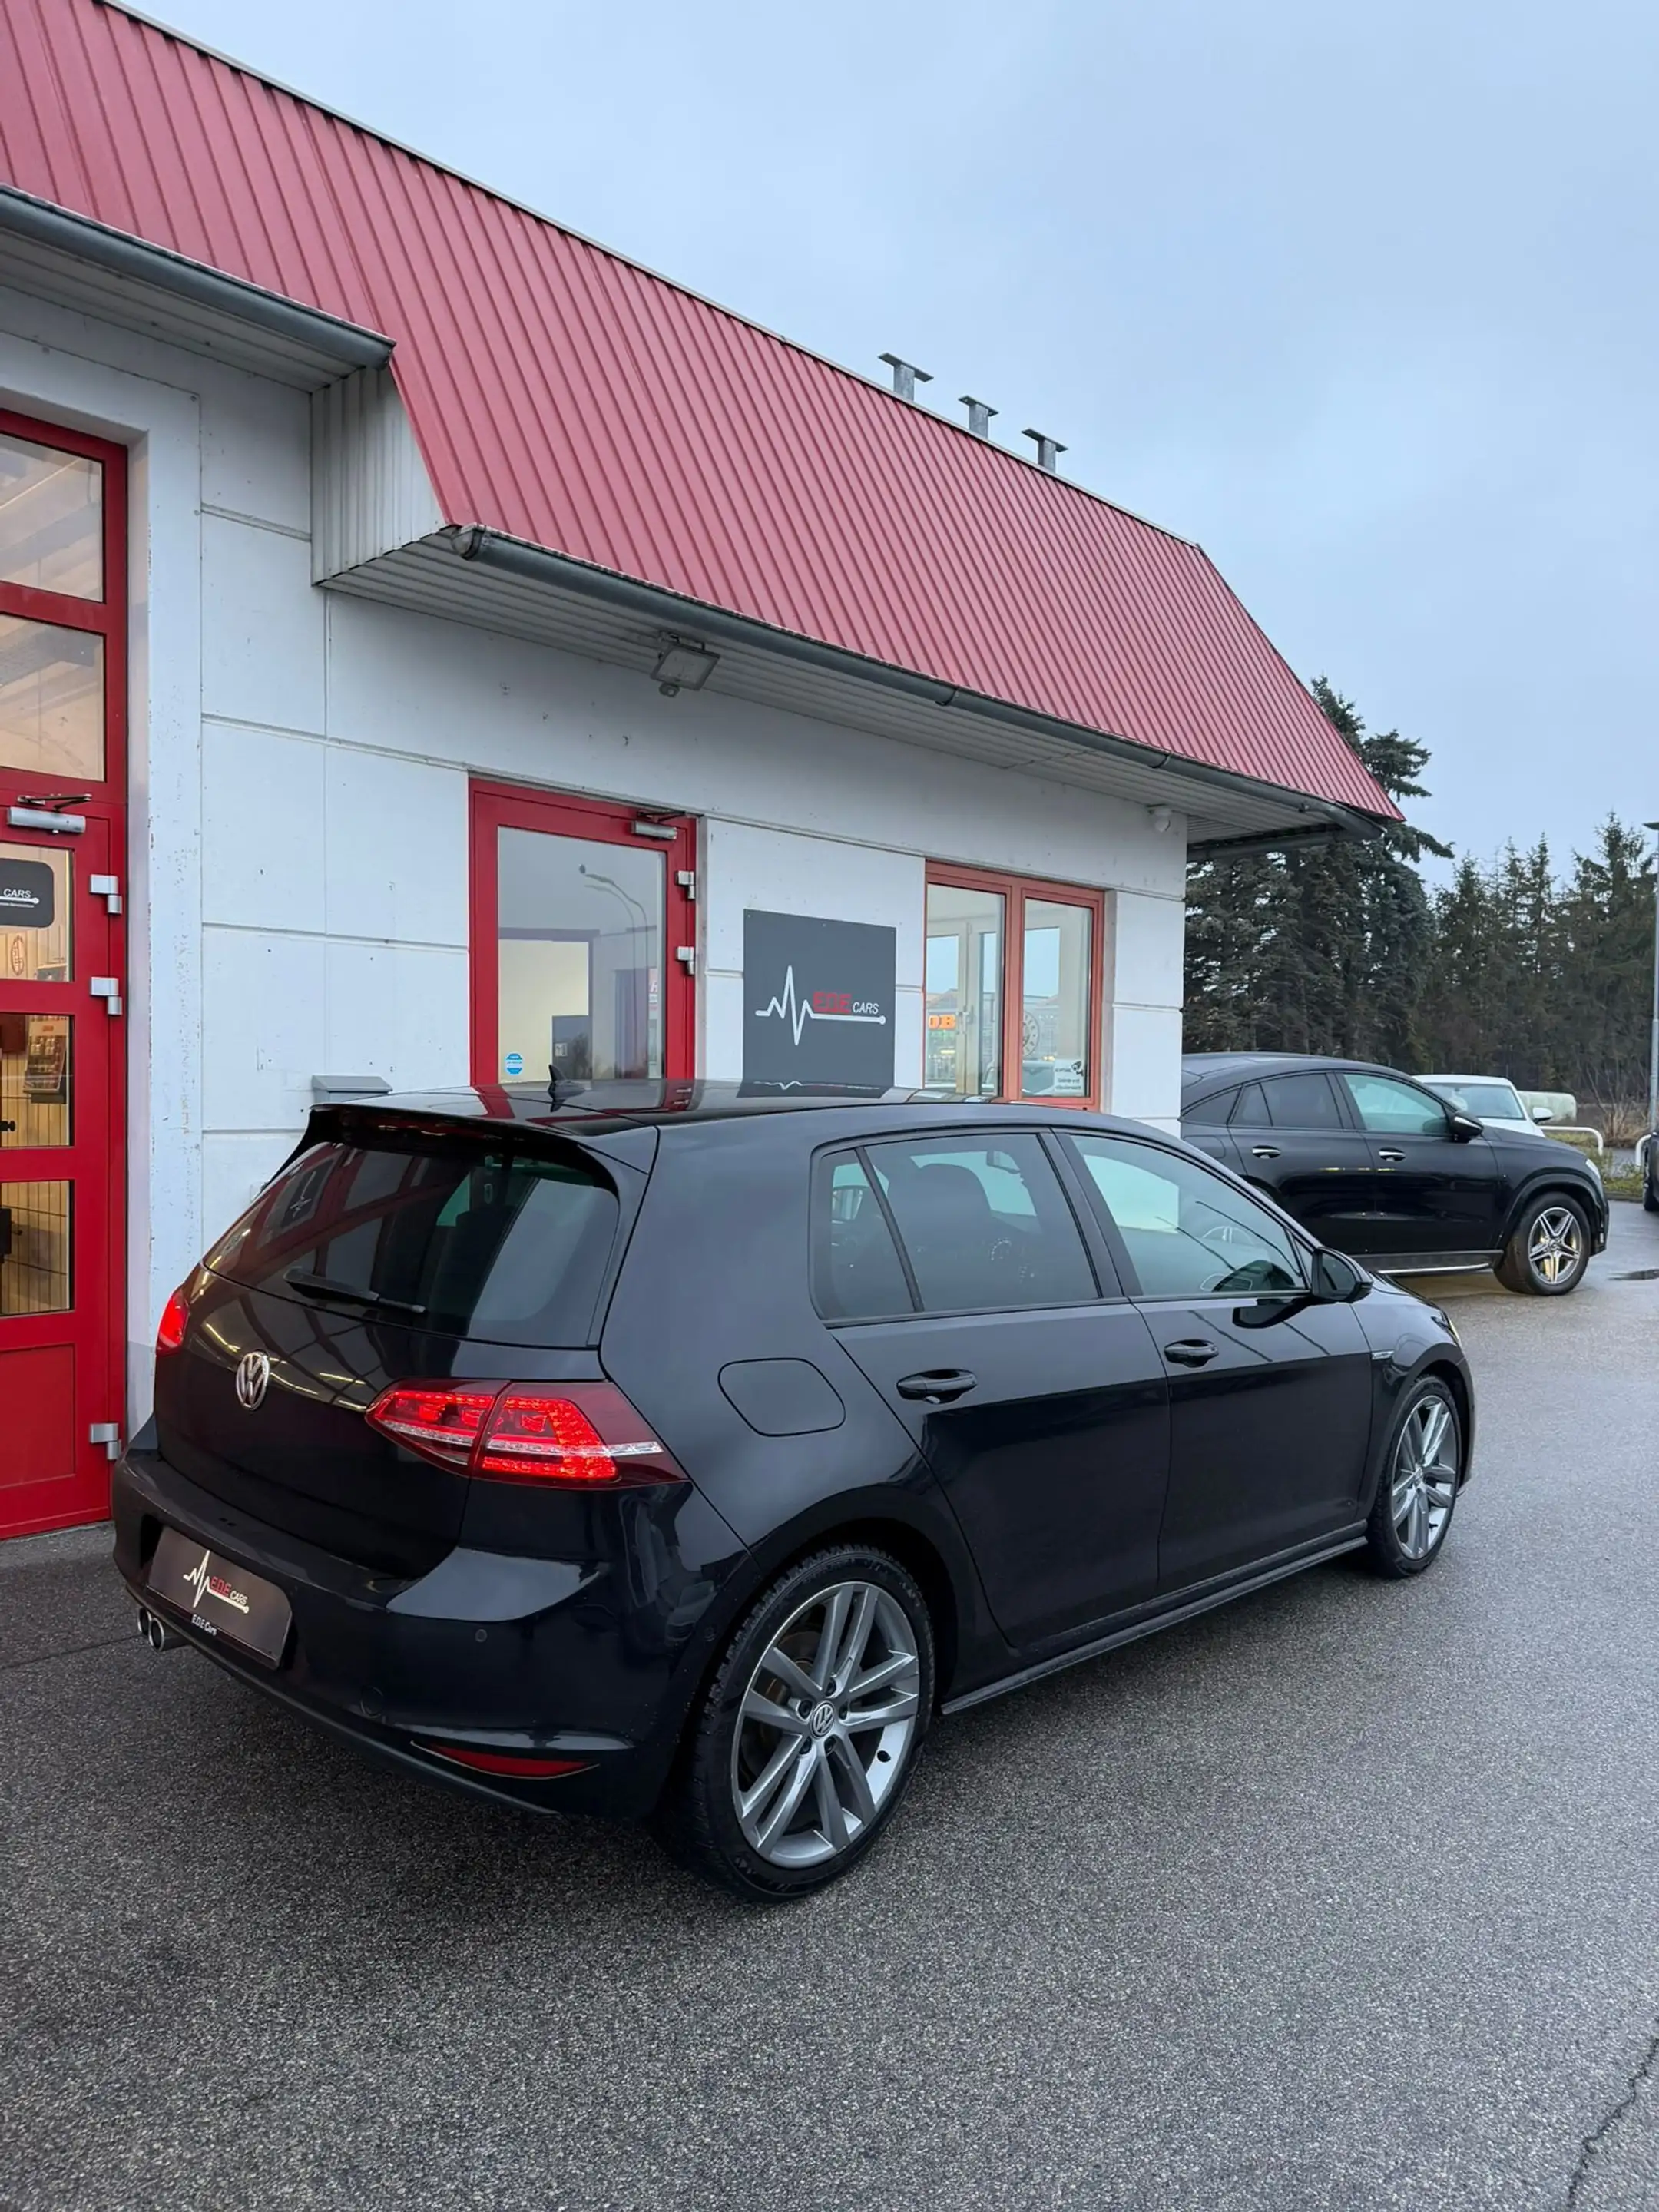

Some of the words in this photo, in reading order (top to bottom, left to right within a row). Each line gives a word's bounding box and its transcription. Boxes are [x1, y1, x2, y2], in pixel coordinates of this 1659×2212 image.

[3, 889, 31, 898] CARS
[853, 1002, 879, 1015] CARS
[230, 1591, 248, 1605] CARS
